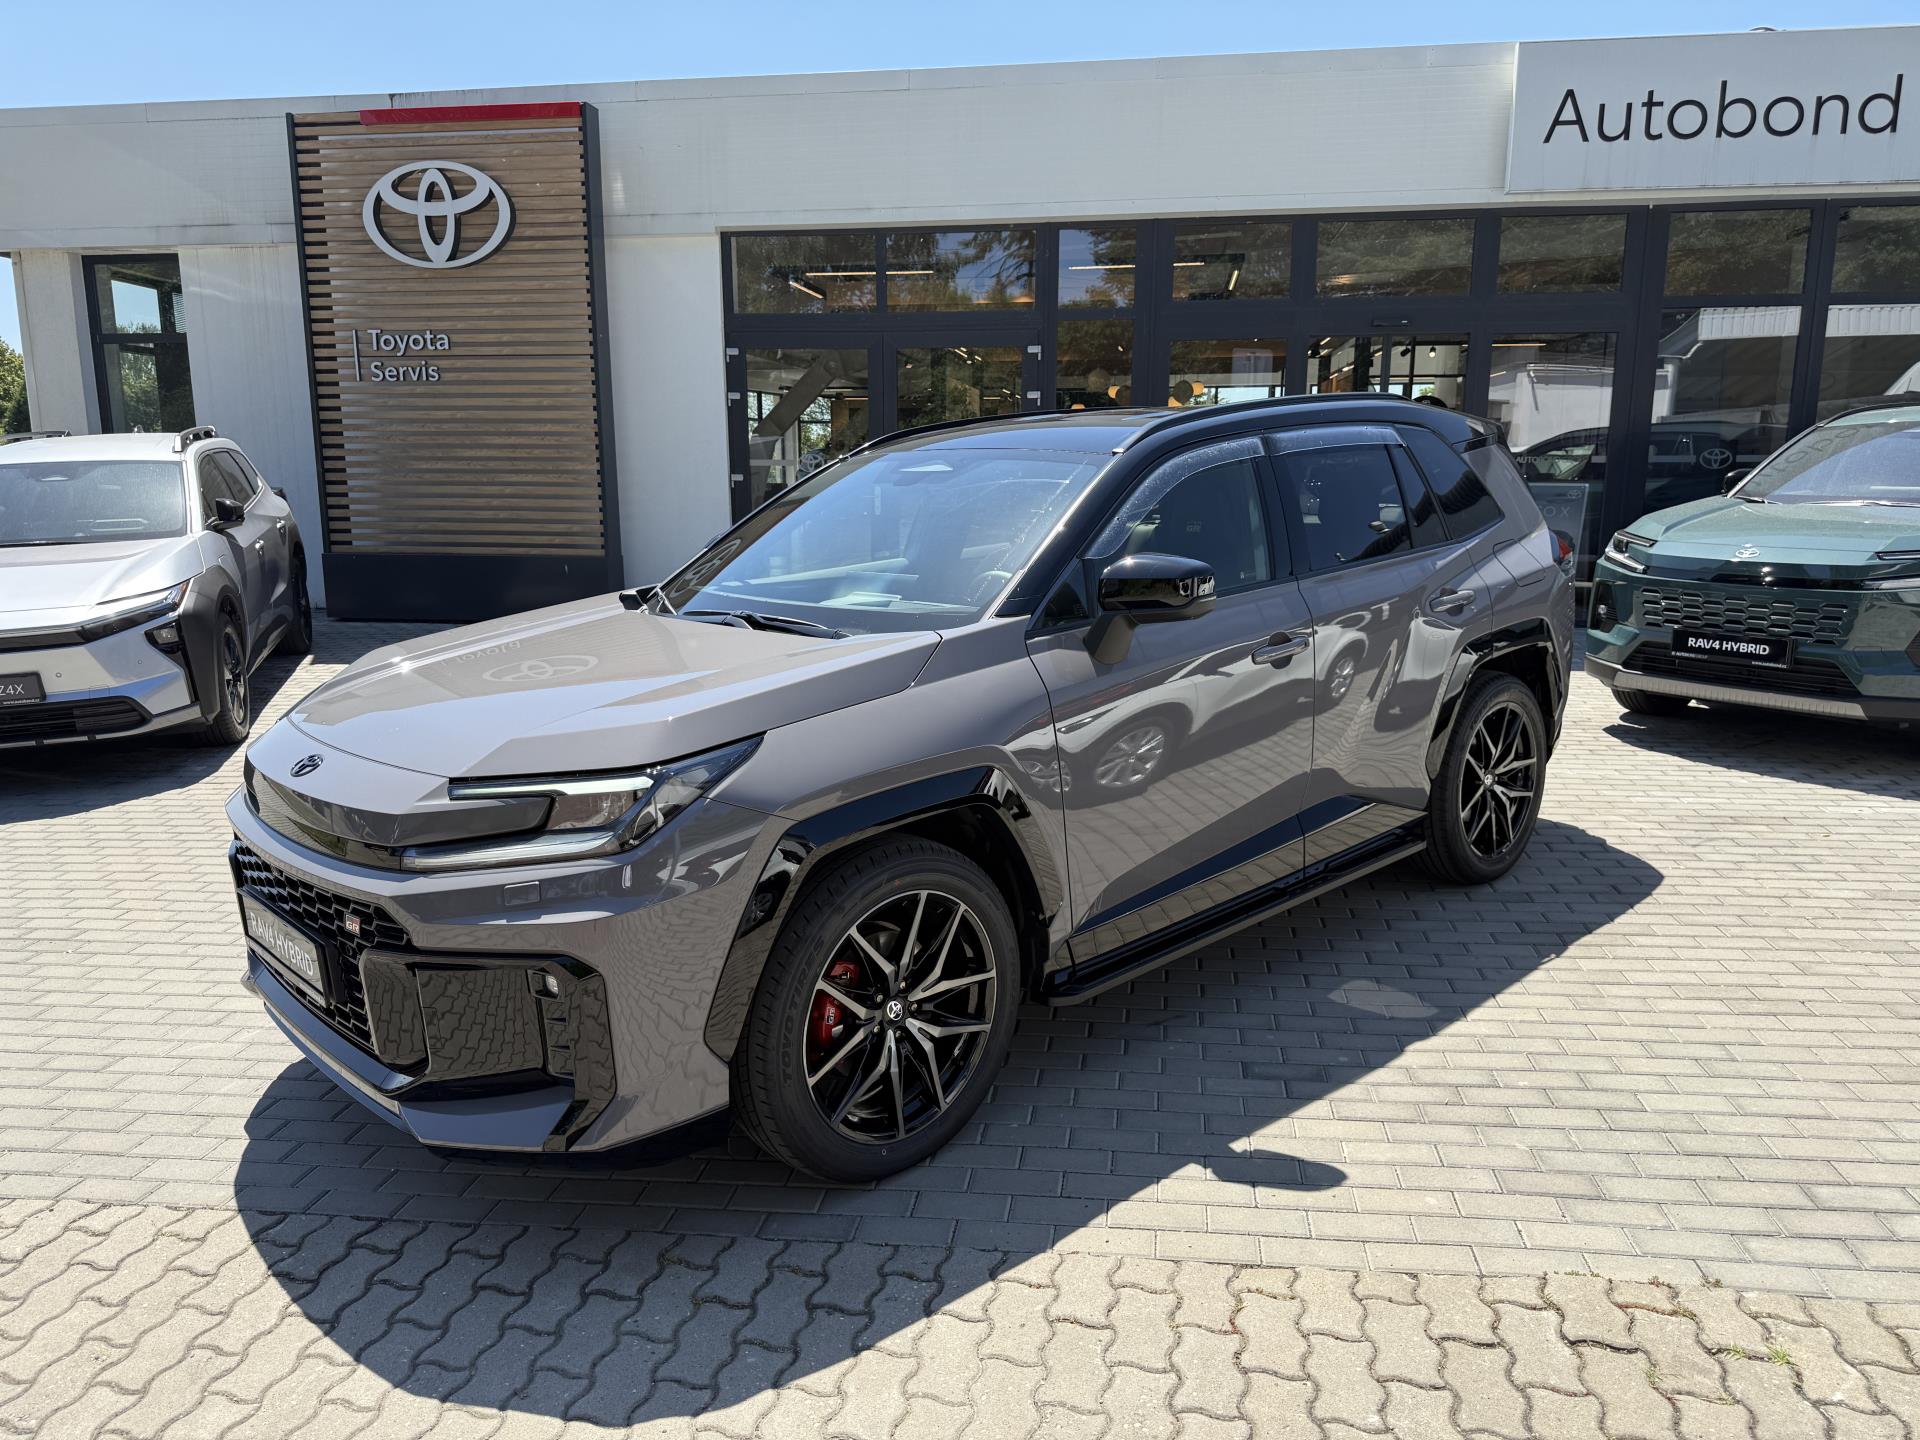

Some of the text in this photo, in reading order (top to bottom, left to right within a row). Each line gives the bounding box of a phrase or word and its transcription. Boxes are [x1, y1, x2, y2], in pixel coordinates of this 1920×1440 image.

[1543, 73, 1903, 144] Autobond
[367, 328, 451, 357] Toyota
[370, 361, 441, 382] Servis
[1687, 637, 1720, 650] RAV4
[1722, 641, 1770, 655] HYBRID
[346, 921, 360, 934] GR
[250, 912, 314, 976] RAV4 HYBRID
